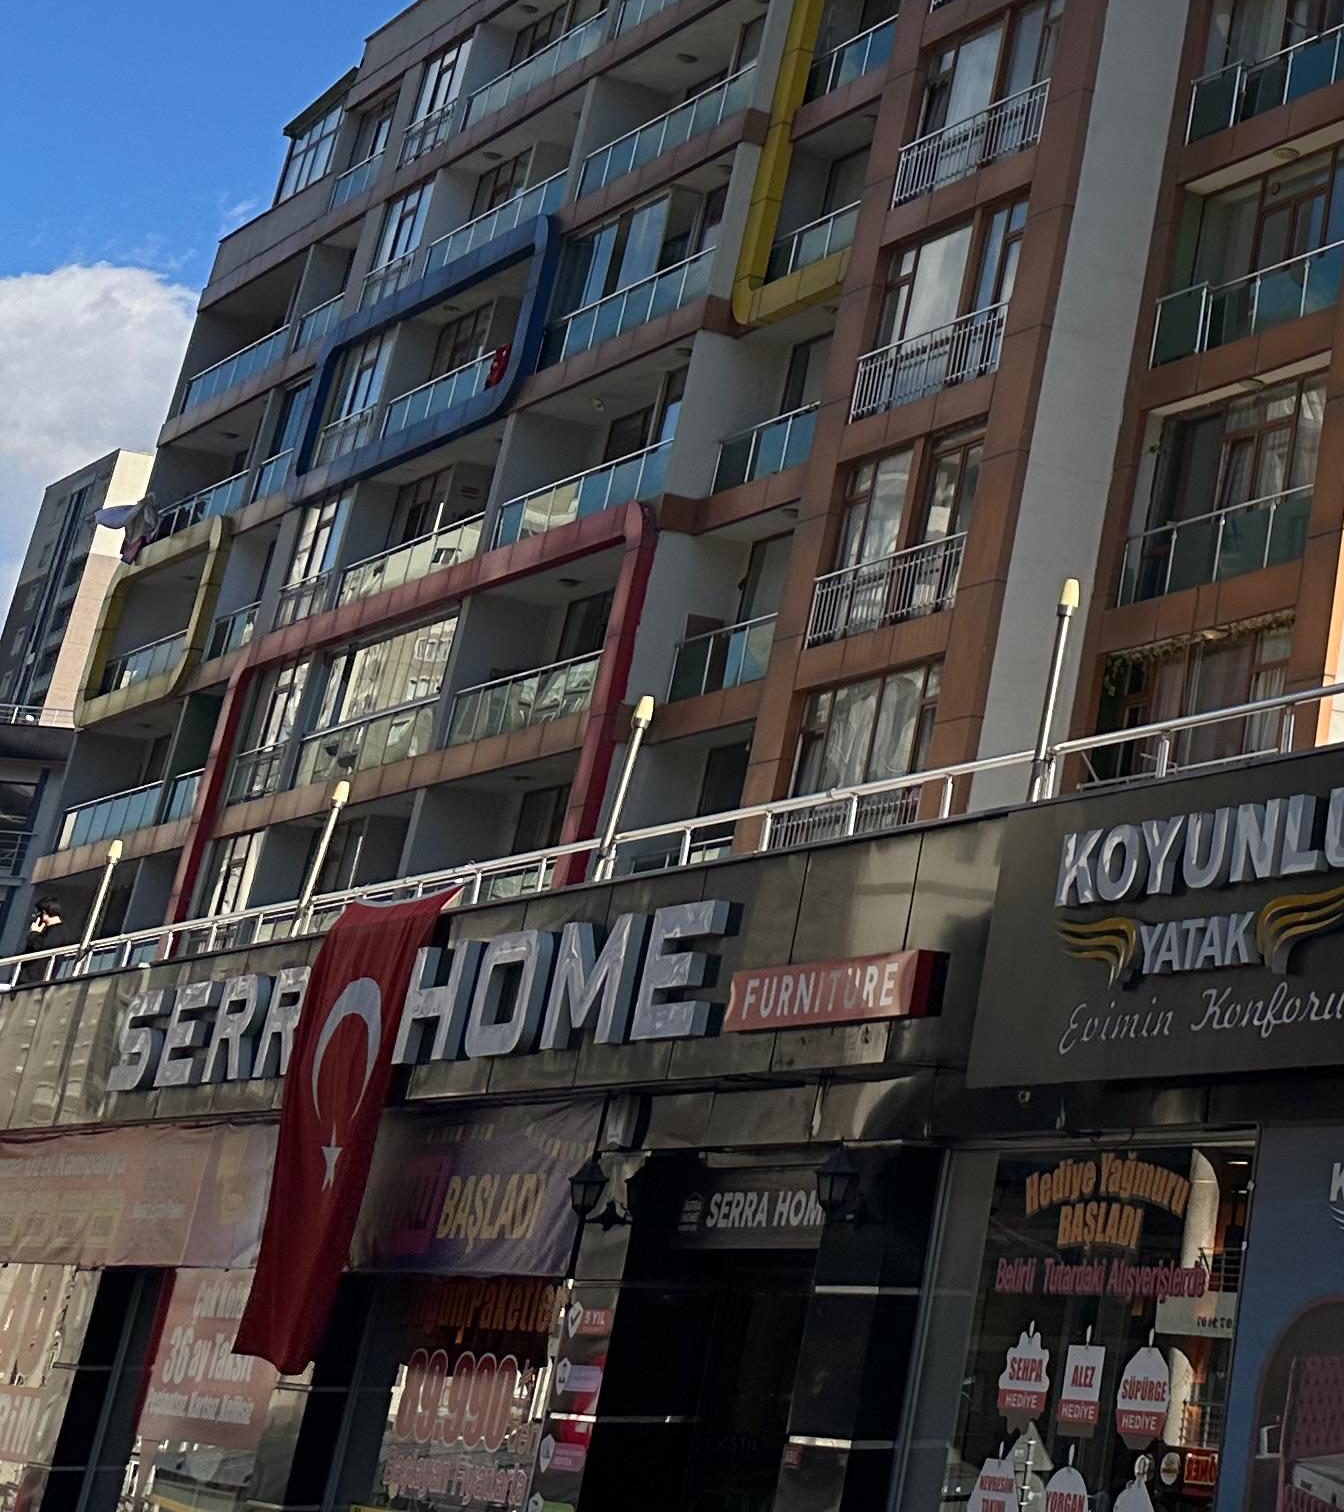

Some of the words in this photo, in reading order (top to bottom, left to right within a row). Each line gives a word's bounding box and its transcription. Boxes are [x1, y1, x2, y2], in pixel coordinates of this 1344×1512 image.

[1140, 911, 1261, 974] YATAK
[106, 966, 313, 1091] SERR
[391, 900, 729, 1065] HOME
[742, 962, 899, 1020] FURNITURE
[1058, 995, 1174, 1054] Evimin
[1025, 1157, 1096, 1218] Hediye
[1098, 1151, 1190, 1219] Yağmuru
[706, 1190, 767, 1229] SERRA
[1057, 1201, 1145, 1255] BAŞLADI
[162, 1326, 195, 1385] 36
[188, 1339, 211, 1383] ay
[1009, 1356, 1044, 1382] SEHPA
[1071, 1364, 1096, 1388] ALEZ
[1005, 1392, 1038, 1409] HEDİYE
[1061, 1401, 1095, 1420] HEDİYE
[1121, 1374, 1167, 1403] SÜPÜRGE
[1121, 1411, 1158, 1431] HEDİYE
